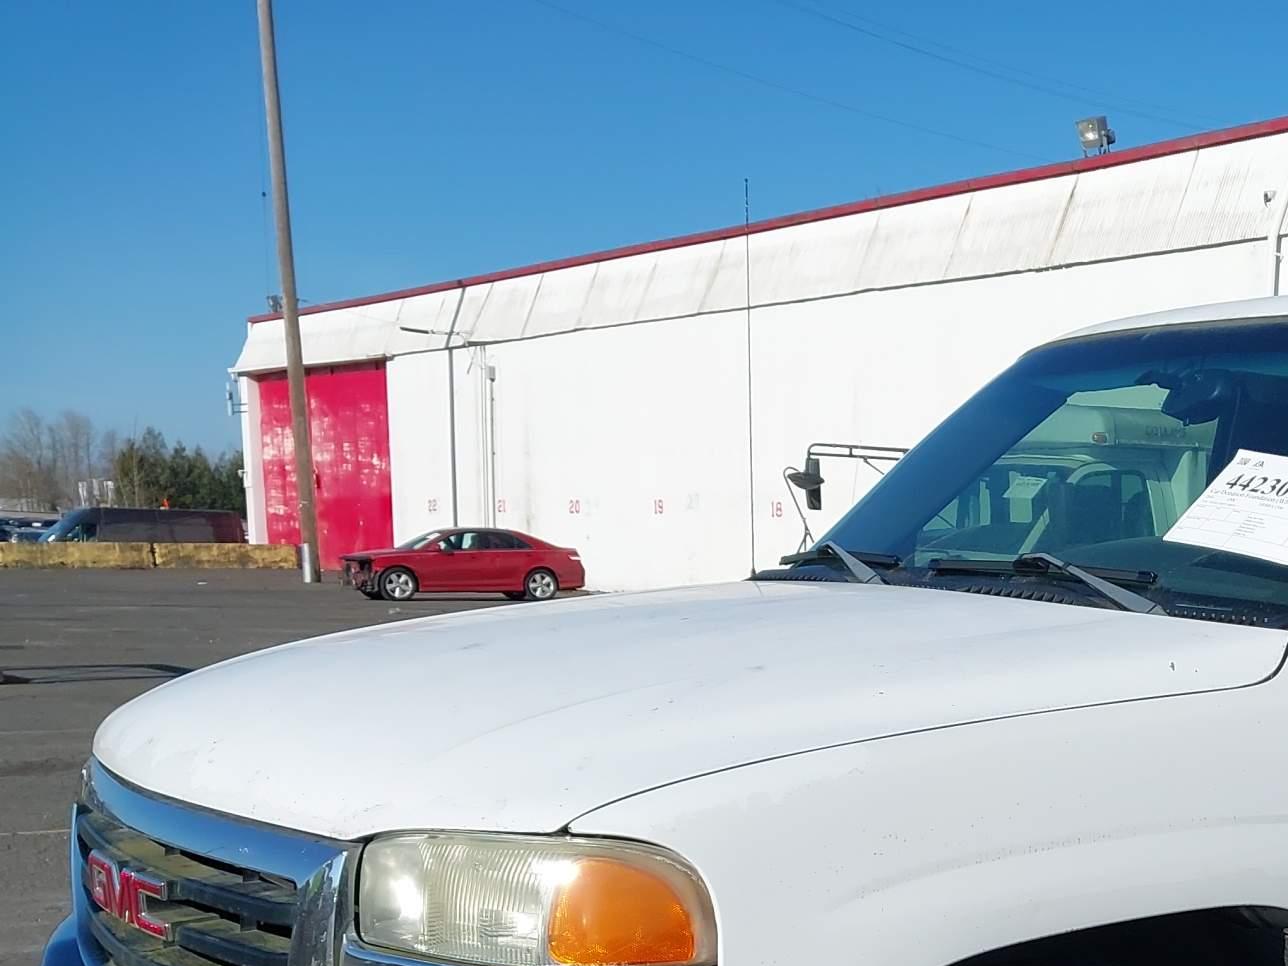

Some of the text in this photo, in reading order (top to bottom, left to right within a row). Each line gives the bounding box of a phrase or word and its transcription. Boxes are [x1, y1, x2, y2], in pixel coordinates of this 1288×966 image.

[497, 499, 506, 513] 21
[568, 499, 580, 514] 20
[654, 499, 664, 515] 19
[771, 501, 783, 518] 18
[88, 848, 174, 941] GMC
